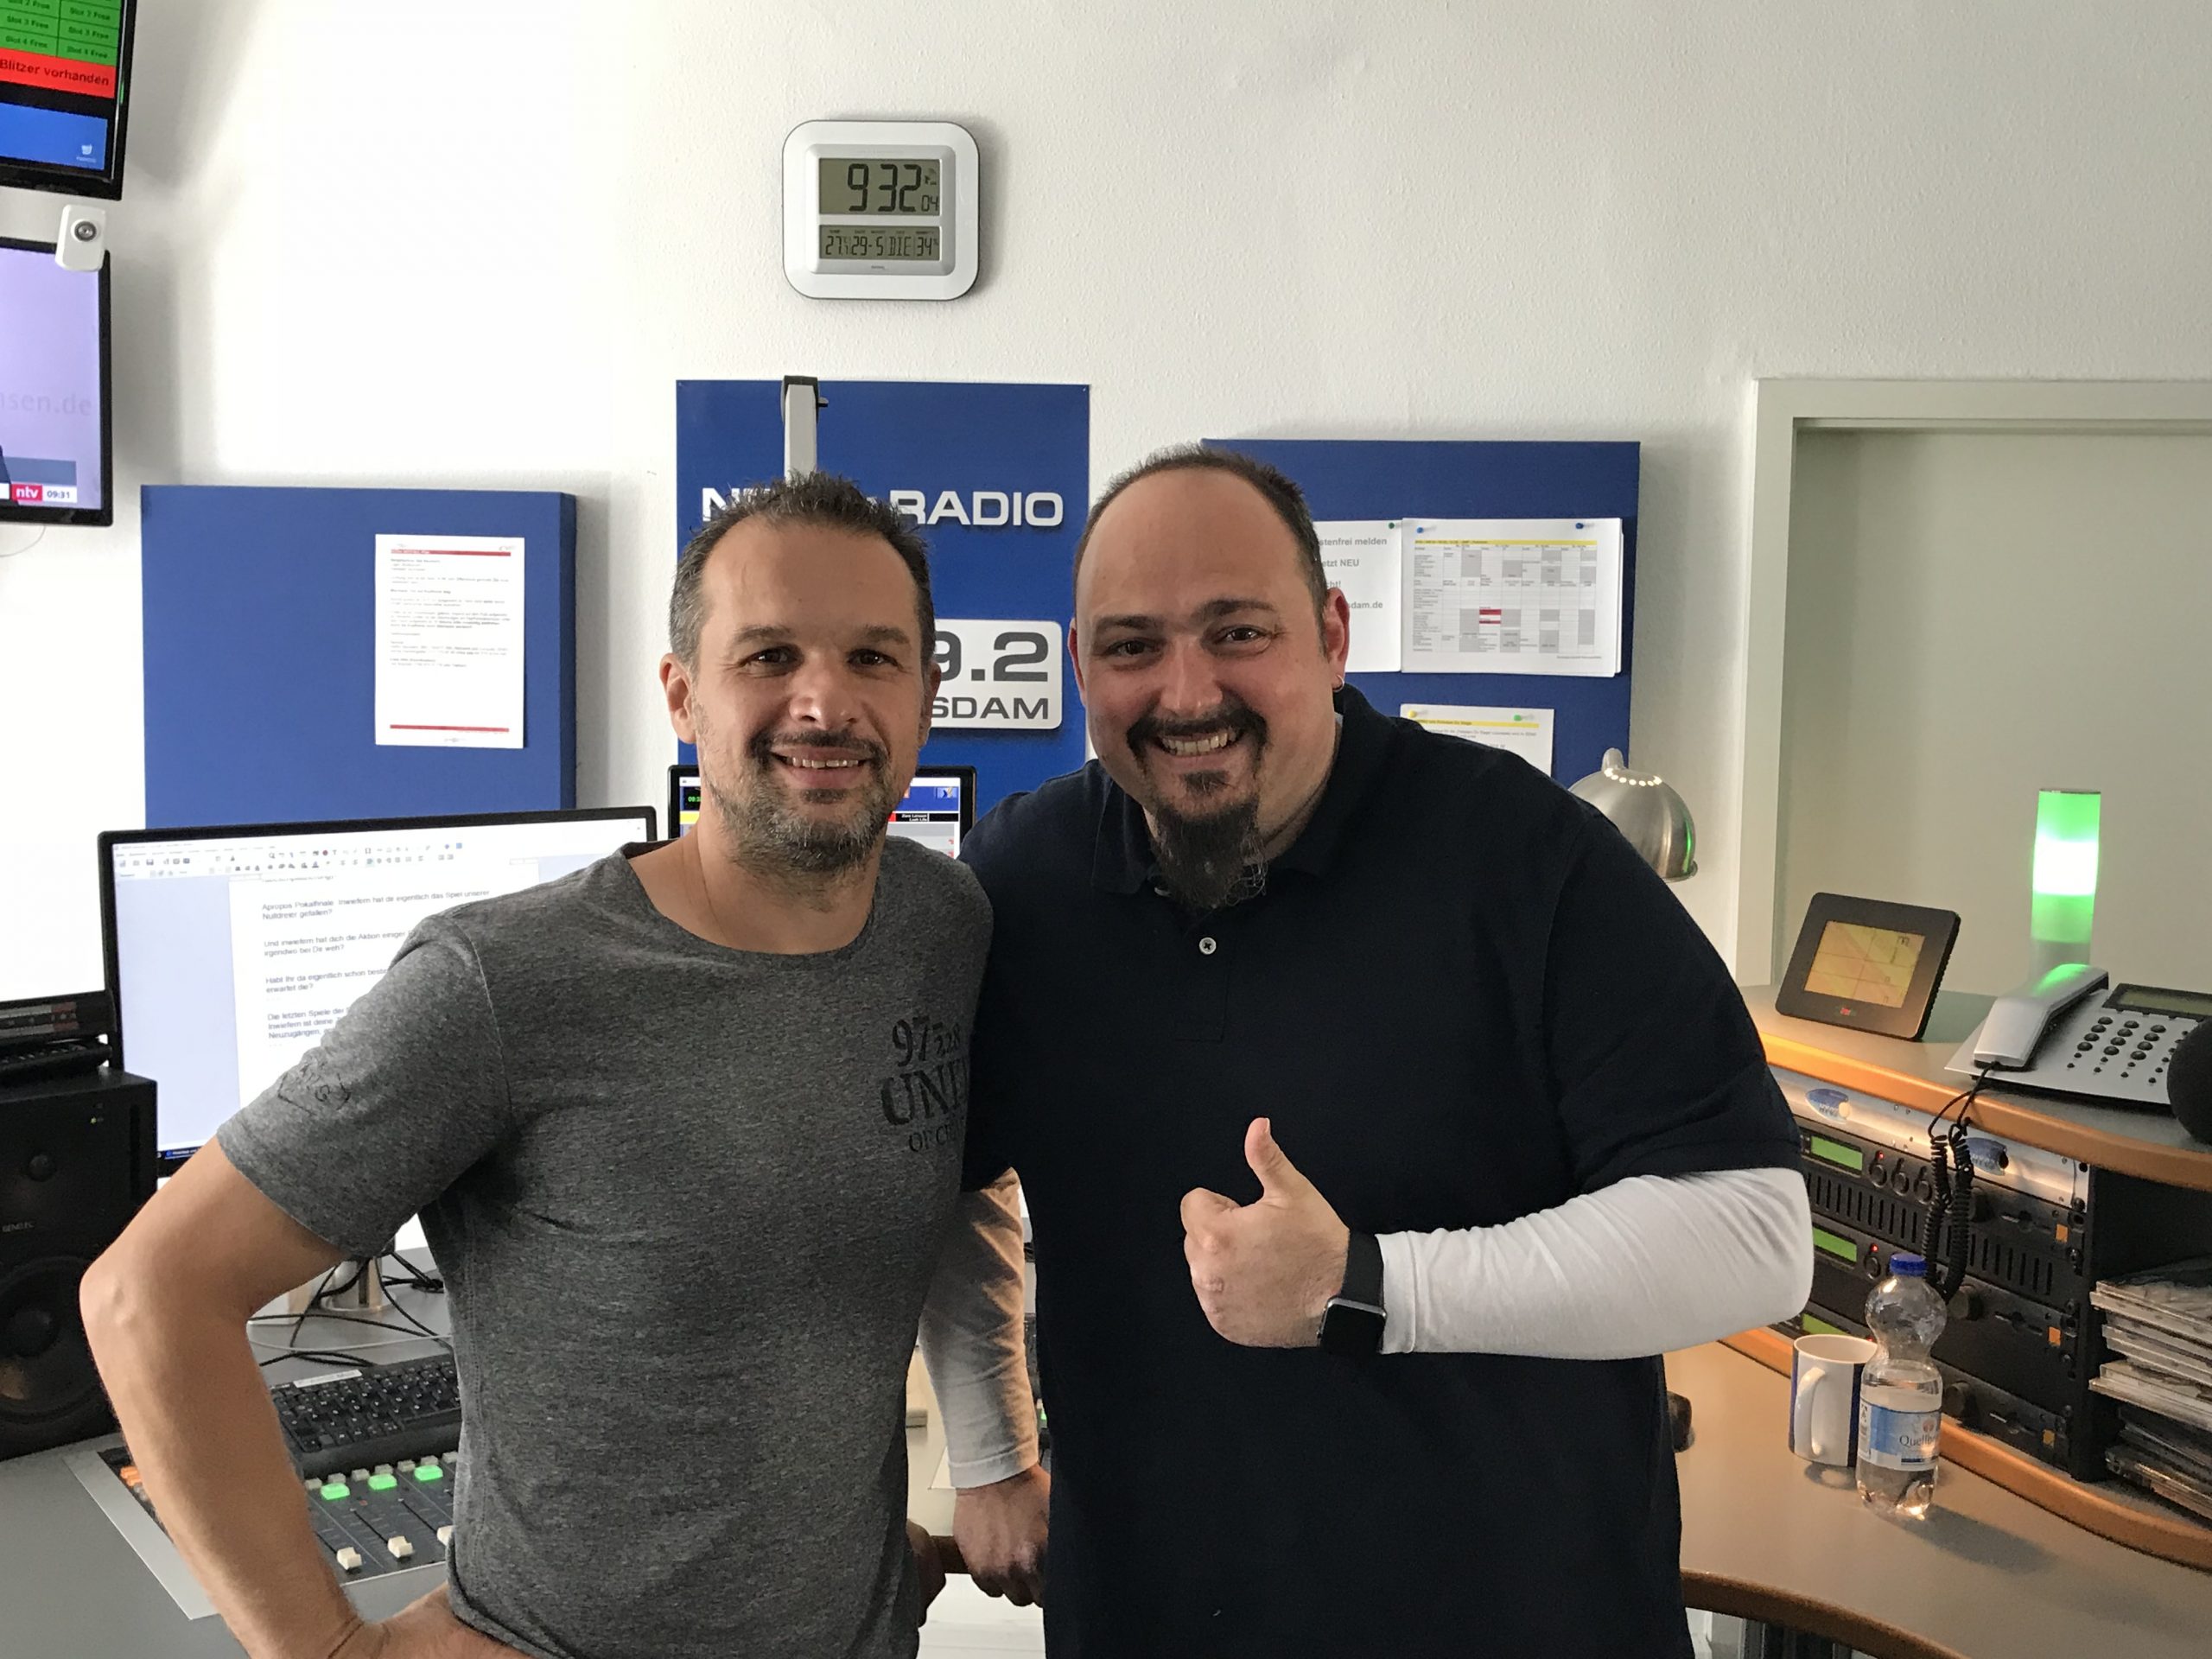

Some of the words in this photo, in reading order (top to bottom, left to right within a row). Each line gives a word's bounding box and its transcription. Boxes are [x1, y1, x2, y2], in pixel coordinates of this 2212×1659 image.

[0, 58, 41, 74] Blitzer
[44, 67, 110, 86] vorhanden
[16, 485, 39, 499] ntv
[47, 490, 71, 499] 09:31
[889, 489, 1064, 527] RADIO
[1319, 537, 1353, 546] stenfrei
[1355, 537, 1388, 546] melden
[935, 631, 1049, 683] 9.2
[931, 696, 1049, 720] SDAM
[262, 903, 293, 912] Apropos
[445, 891, 463, 899] Spiel
[325, 944, 345, 952] weh?
[308, 972, 343, 982] eigentlich
[265, 985, 296, 994] erwartet
[297, 982, 314, 991] die?
[267, 1013, 280, 1021] Die
[282, 1011, 307, 1020] letzten
[308, 1009, 331, 1018] Spiele
[268, 1021, 302, 1030] Inwiefern
[892, 1014, 930, 1067] 97
